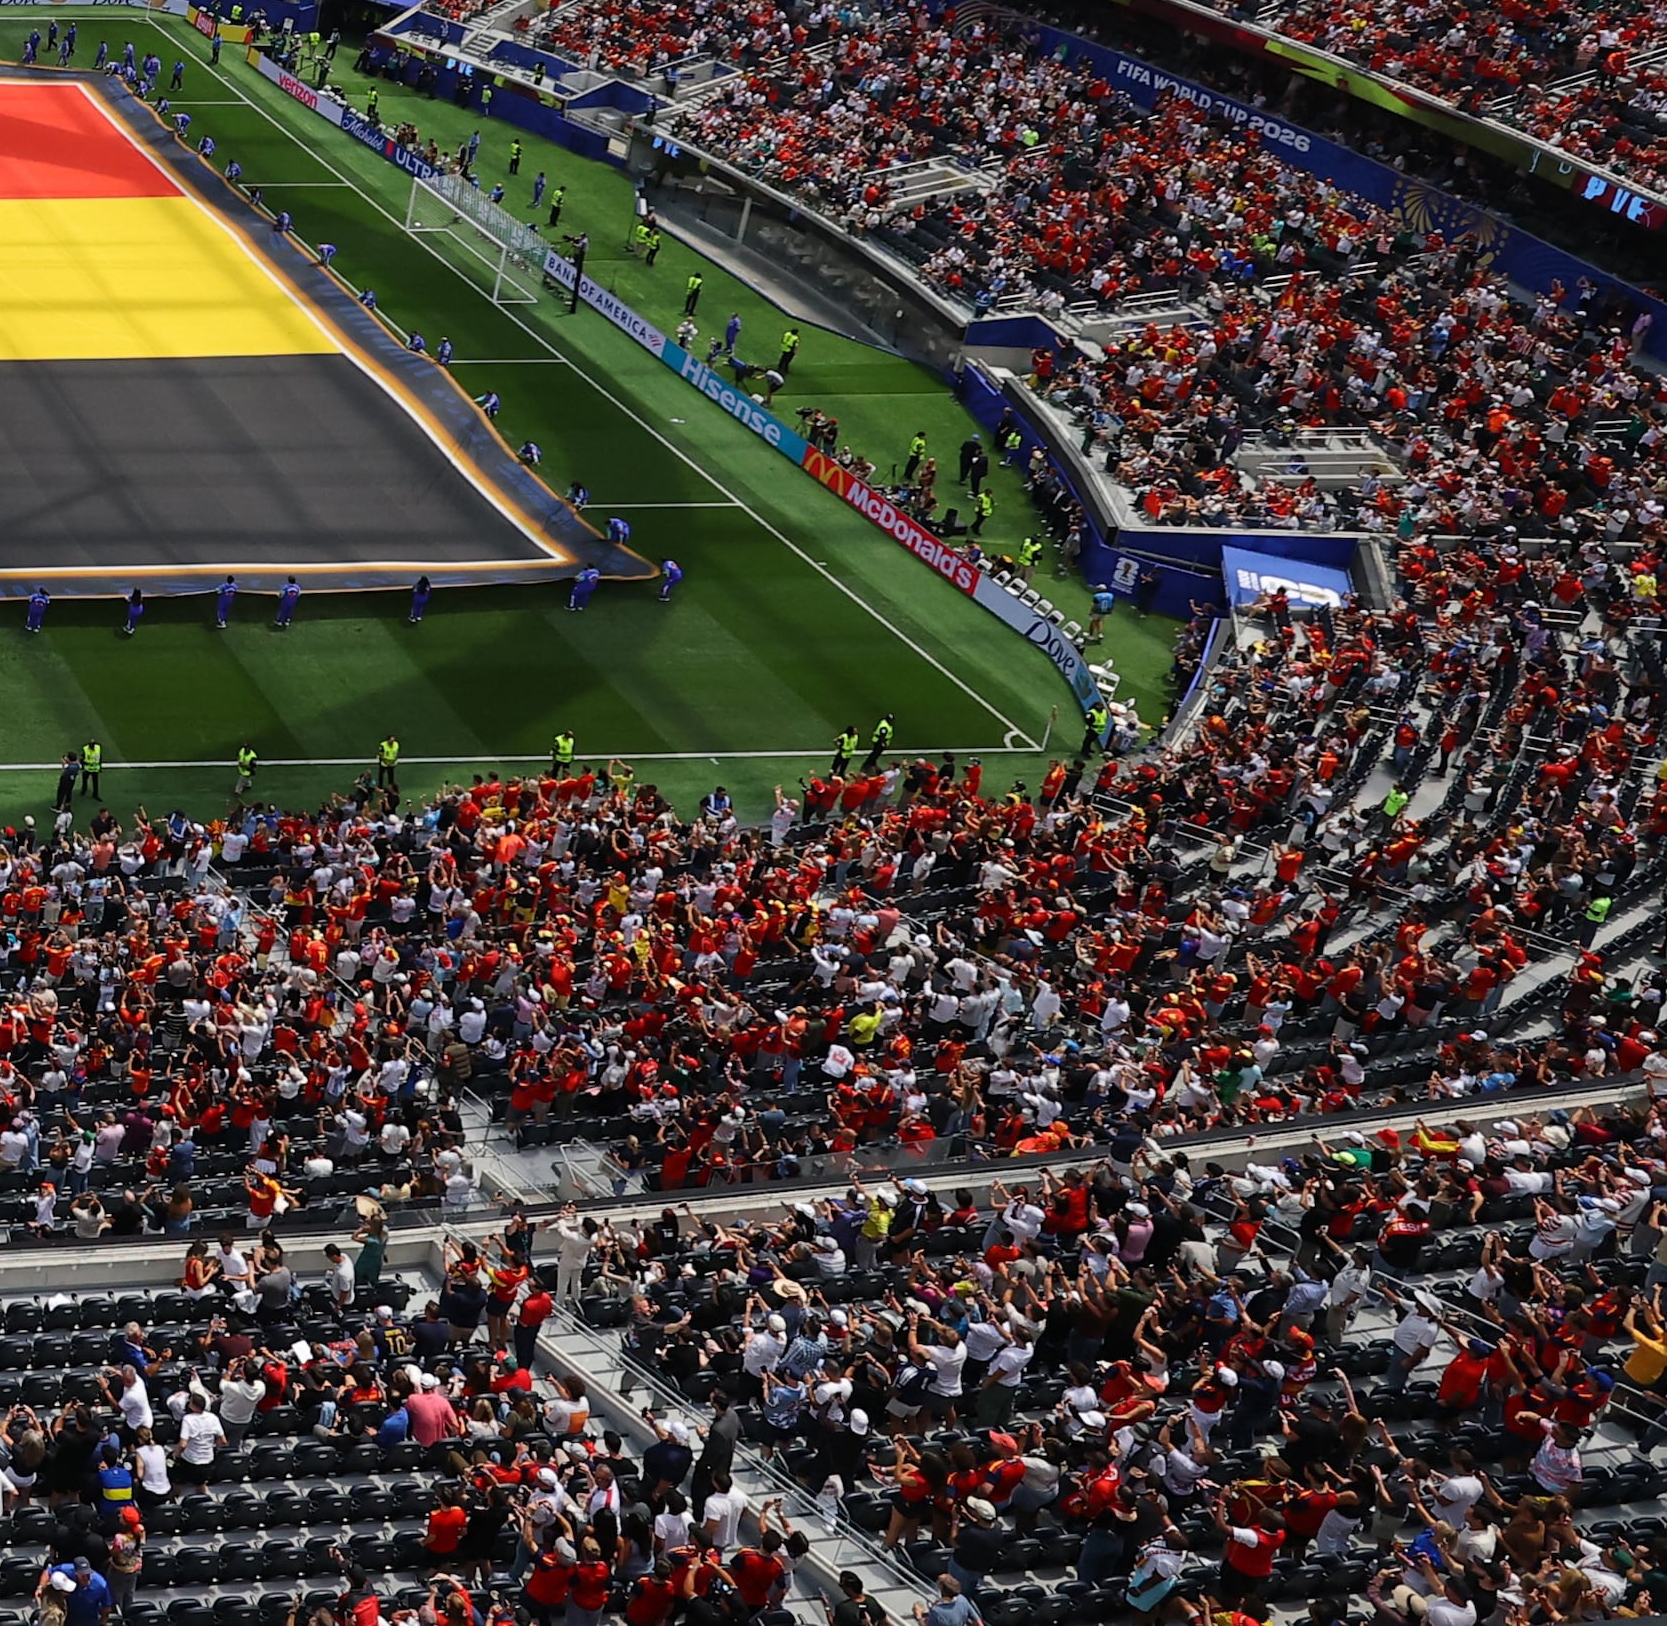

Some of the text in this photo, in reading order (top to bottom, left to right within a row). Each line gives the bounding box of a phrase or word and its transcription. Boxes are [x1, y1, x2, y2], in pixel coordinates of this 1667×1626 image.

[277, 72, 318, 109] verizon
[1116, 60, 1152, 86] FIFA
[1249, 115, 1311, 153] 2026
[341, 112, 384, 151] Michelob
[579, 275, 596, 297] OF
[594, 289, 648, 342] AMERICA
[680, 352, 783, 449] Hisense
[846, 480, 974, 591] McDonald's
[1025, 620, 1075, 677] Dove
[384, 1335, 406, 1355] 10
